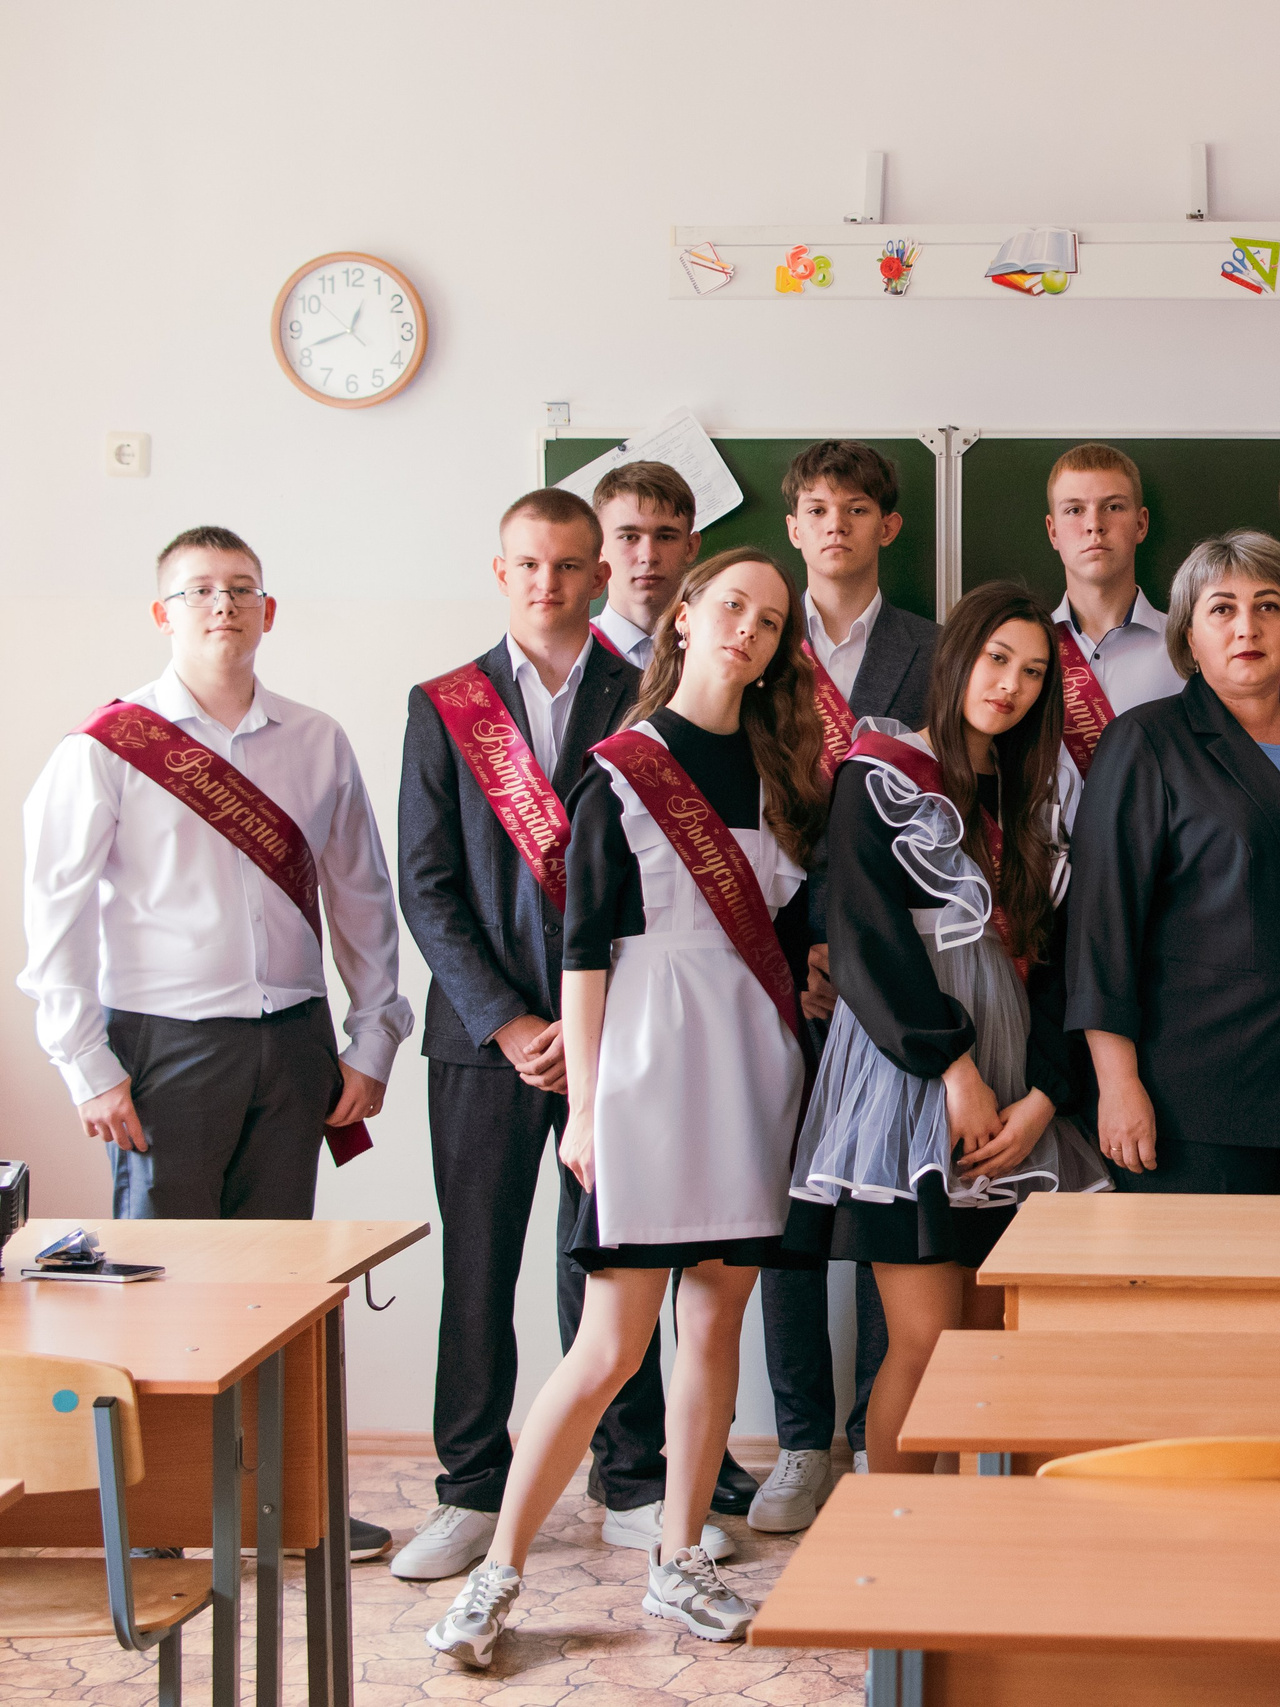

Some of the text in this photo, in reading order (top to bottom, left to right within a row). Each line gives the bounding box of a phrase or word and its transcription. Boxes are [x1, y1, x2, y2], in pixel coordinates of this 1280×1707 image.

[318, 275, 335, 294] 11
[342, 268, 365, 288] 12
[374, 276, 382, 295] 1
[298, 295, 321, 315] 10
[390, 294, 404, 314] 2
[289, 320, 303, 340] 9
[401, 322, 414, 342] 3
[299, 347, 313, 368] 8
[390, 350, 404, 369] 4
[320, 368, 334, 387] 7
[345, 374, 359, 394] 6
[371, 368, 385, 388] 5
[472, 718, 560, 853] Выпускник
[165, 748, 292, 862] Выпускник
[666, 795, 757, 943] Выпускница
